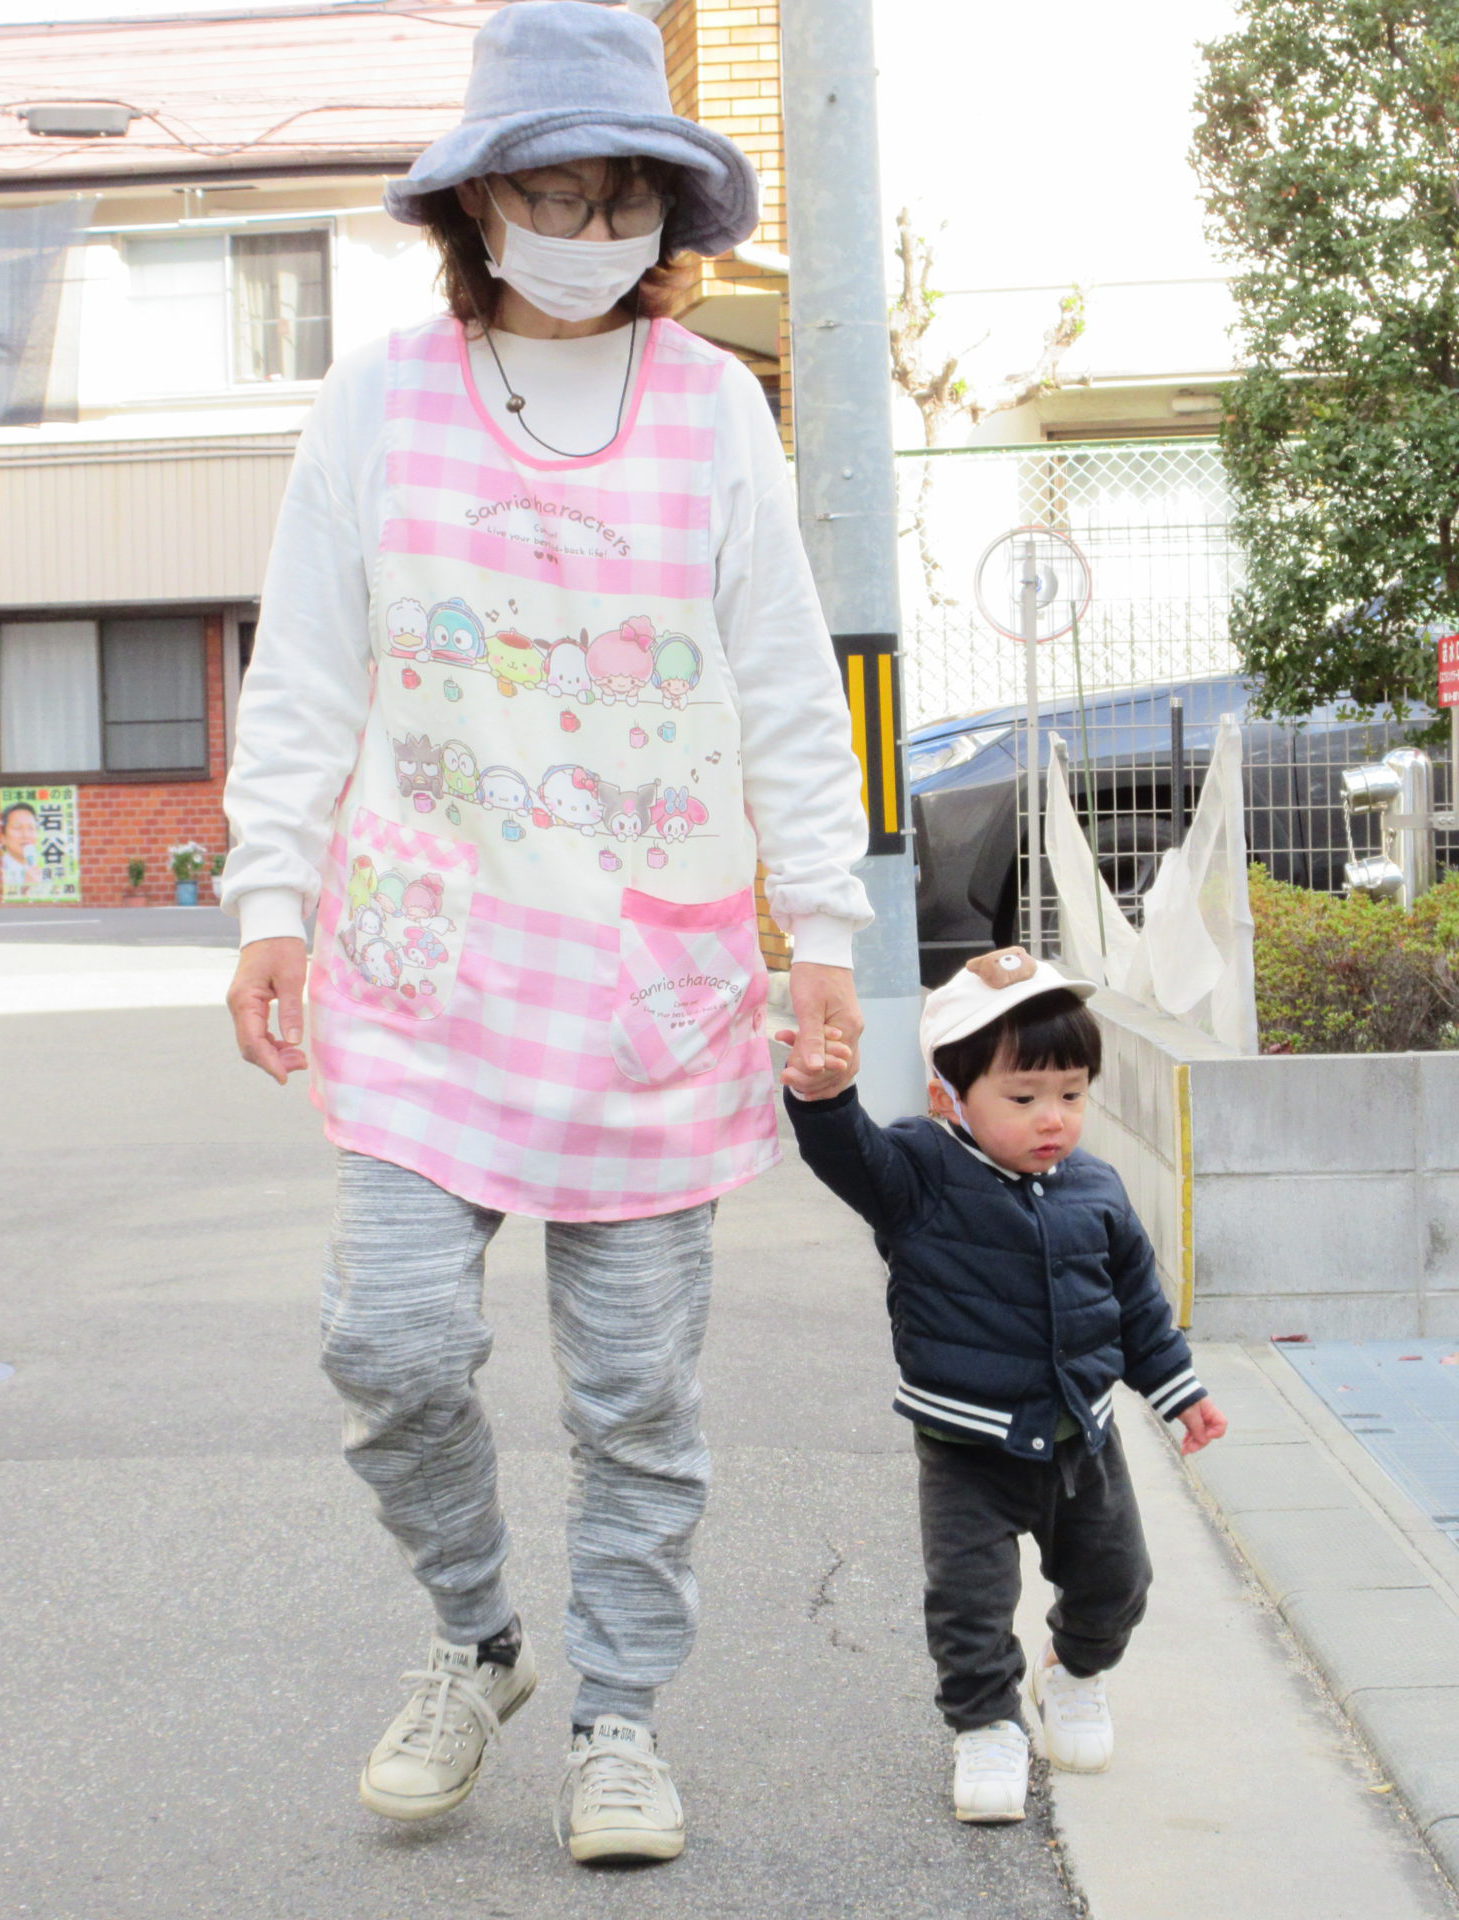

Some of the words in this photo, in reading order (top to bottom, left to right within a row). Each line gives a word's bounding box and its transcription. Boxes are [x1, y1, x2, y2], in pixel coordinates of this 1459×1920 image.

[465, 494, 531, 526] Sanrio
[533, 495, 631, 557] haracters
[39, 804, 64, 864] 岩谷
[630, 977, 675, 1006] Sanrio
